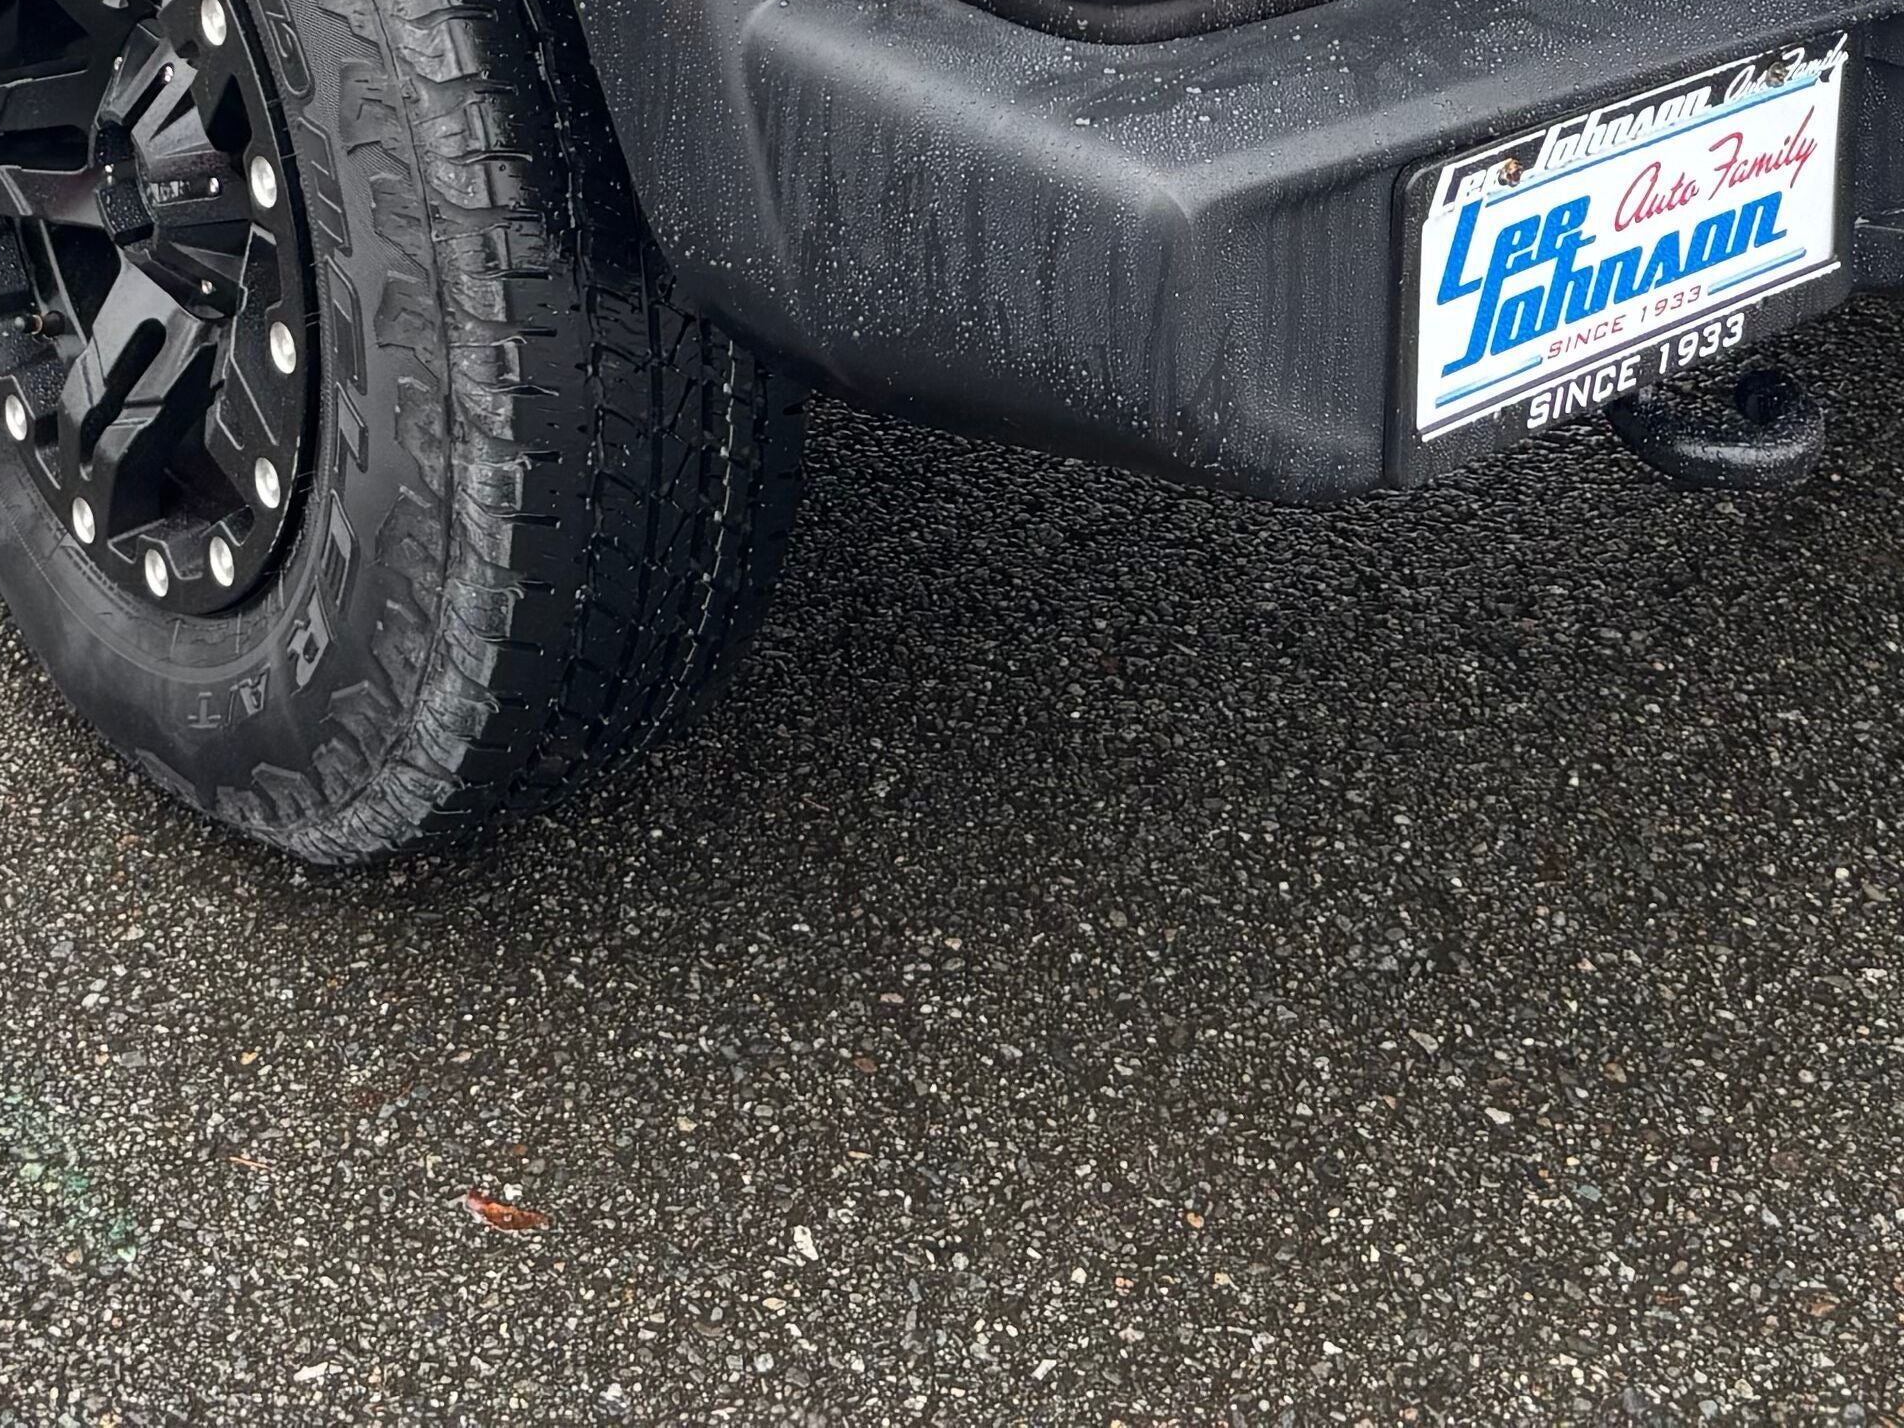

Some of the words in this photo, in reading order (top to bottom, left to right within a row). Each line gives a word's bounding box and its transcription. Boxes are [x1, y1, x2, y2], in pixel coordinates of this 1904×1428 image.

[1521, 86, 1712, 180] Johnson
[1782, 33, 1849, 84] Family
[1613, 161, 1699, 232] Auto
[1708, 105, 1818, 201] Family
[1437, 194, 1595, 305] Lee
[1441, 191, 1788, 378] Johnson
[1526, 353, 1639, 431] SINCE
[1658, 312, 1747, 376] 1933
[1546, 313, 1625, 360] SINCE
[1639, 284, 1703, 324] 1933
